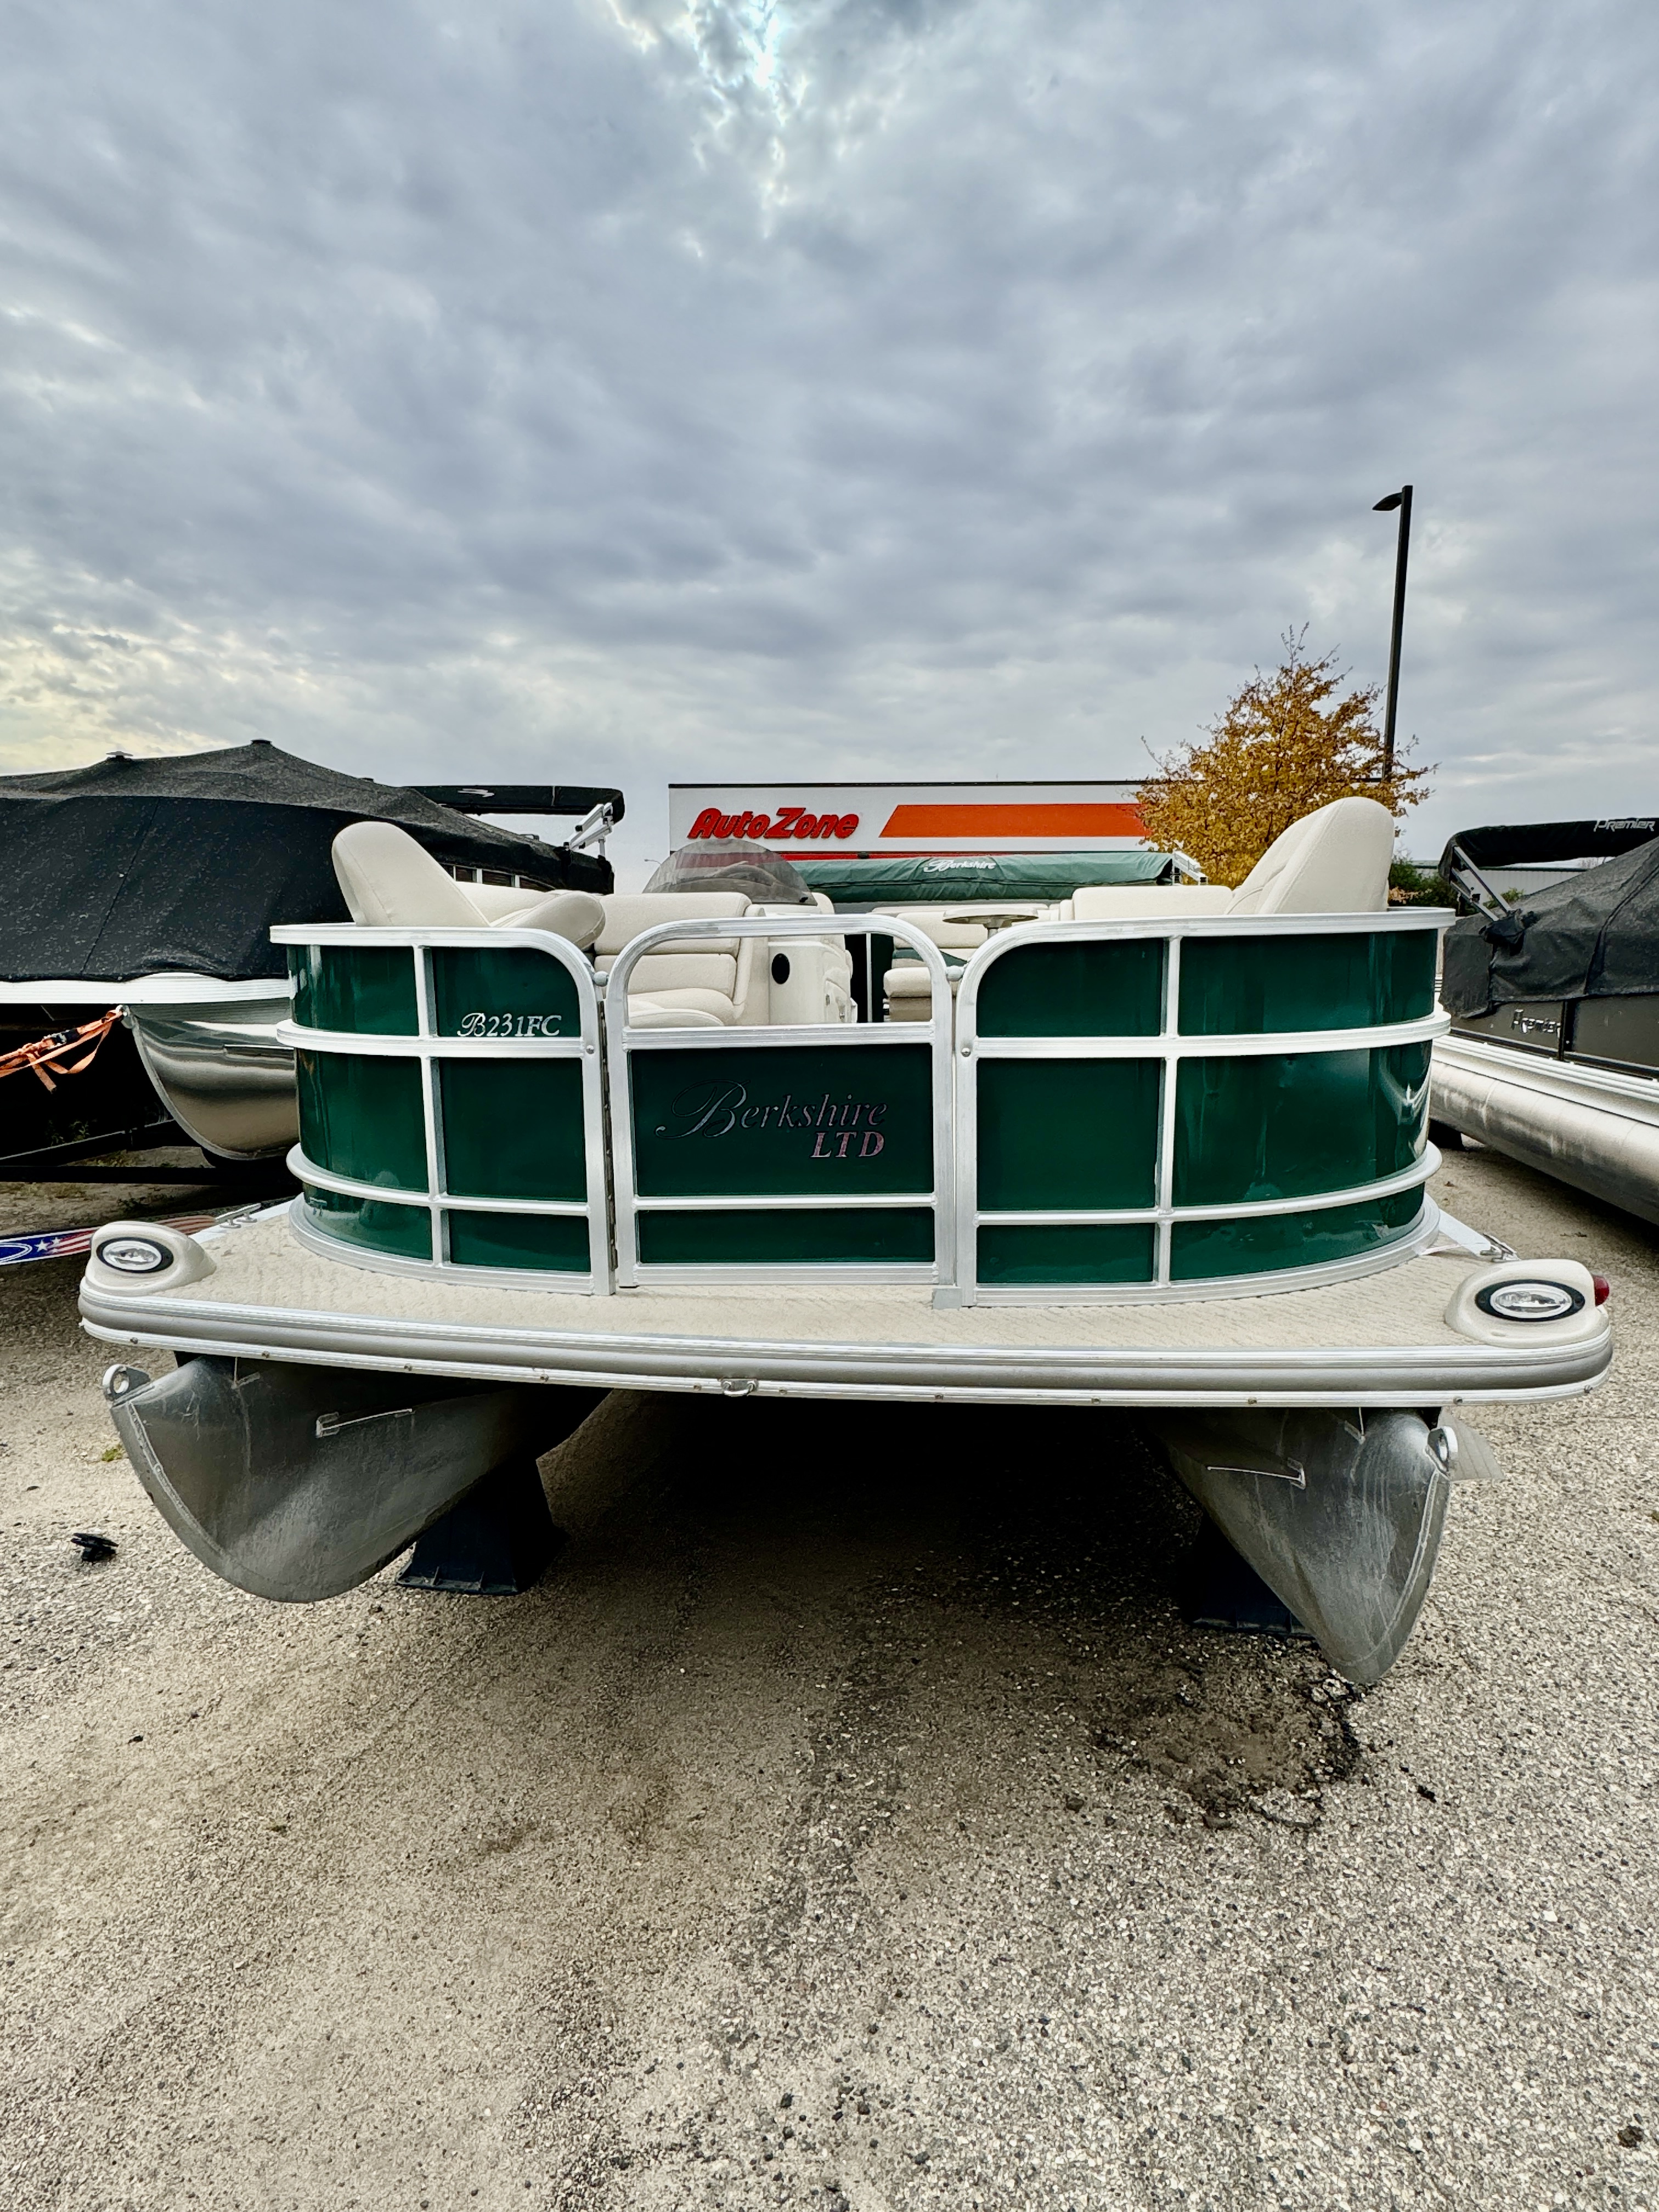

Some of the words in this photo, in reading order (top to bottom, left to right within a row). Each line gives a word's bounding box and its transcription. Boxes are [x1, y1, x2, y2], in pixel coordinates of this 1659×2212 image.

[687, 807, 859, 839] AutoZone
[923, 859, 996, 872] Berkshire
[457, 1013, 562, 1037] B231FC
[656, 1079, 888, 1139] Berkshire
[810, 1131, 885, 1158] LTD
